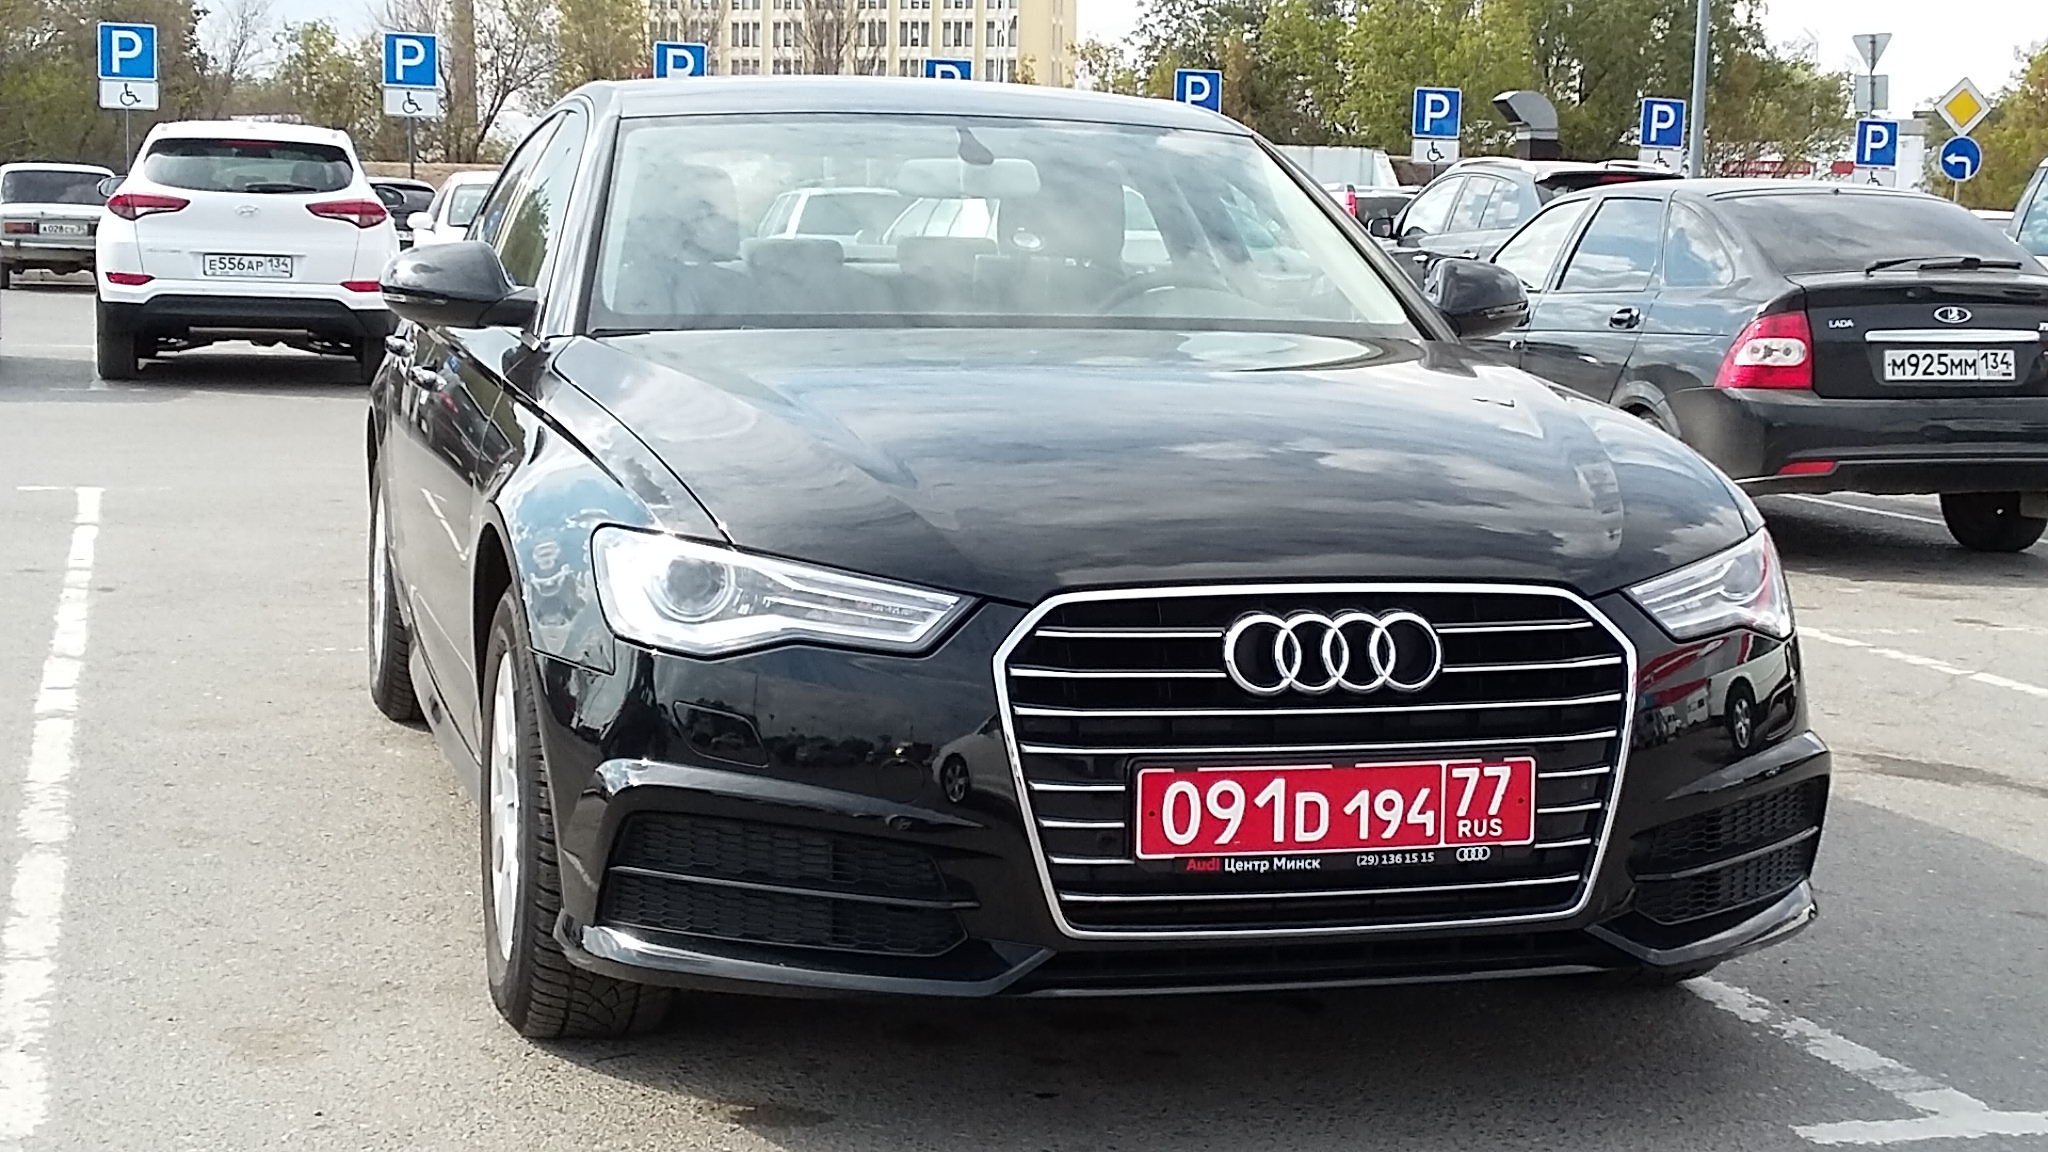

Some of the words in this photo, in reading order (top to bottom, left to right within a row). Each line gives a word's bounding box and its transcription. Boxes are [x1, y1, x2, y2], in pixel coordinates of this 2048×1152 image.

[112, 30, 142, 73] P
[396, 38, 425, 80] P
[667, 48, 694, 78] P
[1186, 75, 1210, 105] P
[1424, 93, 1450, 131] P
[1650, 104, 1675, 141] P
[1864, 125, 1889, 161] P
[268, 258, 289, 268] 134
[1828, 319, 1854, 329] LADA
[1980, 352, 2011, 369] 134
[1162, 778, 1330, 846] 091D
[1343, 787, 1435, 840] 194
[1452, 766, 1511, 817] 77
[1458, 818, 1503, 838] RUS
[1186, 858, 1221, 872] Audi
[1225, 858, 1269, 873] Центр
[1273, 856, 1321, 870] Минск
[1356, 854, 1379, 867] (29)
[1381, 853, 1402, 865] 136
[1405, 852, 1419, 864] 15
[1421, 852, 1435, 863] 15
